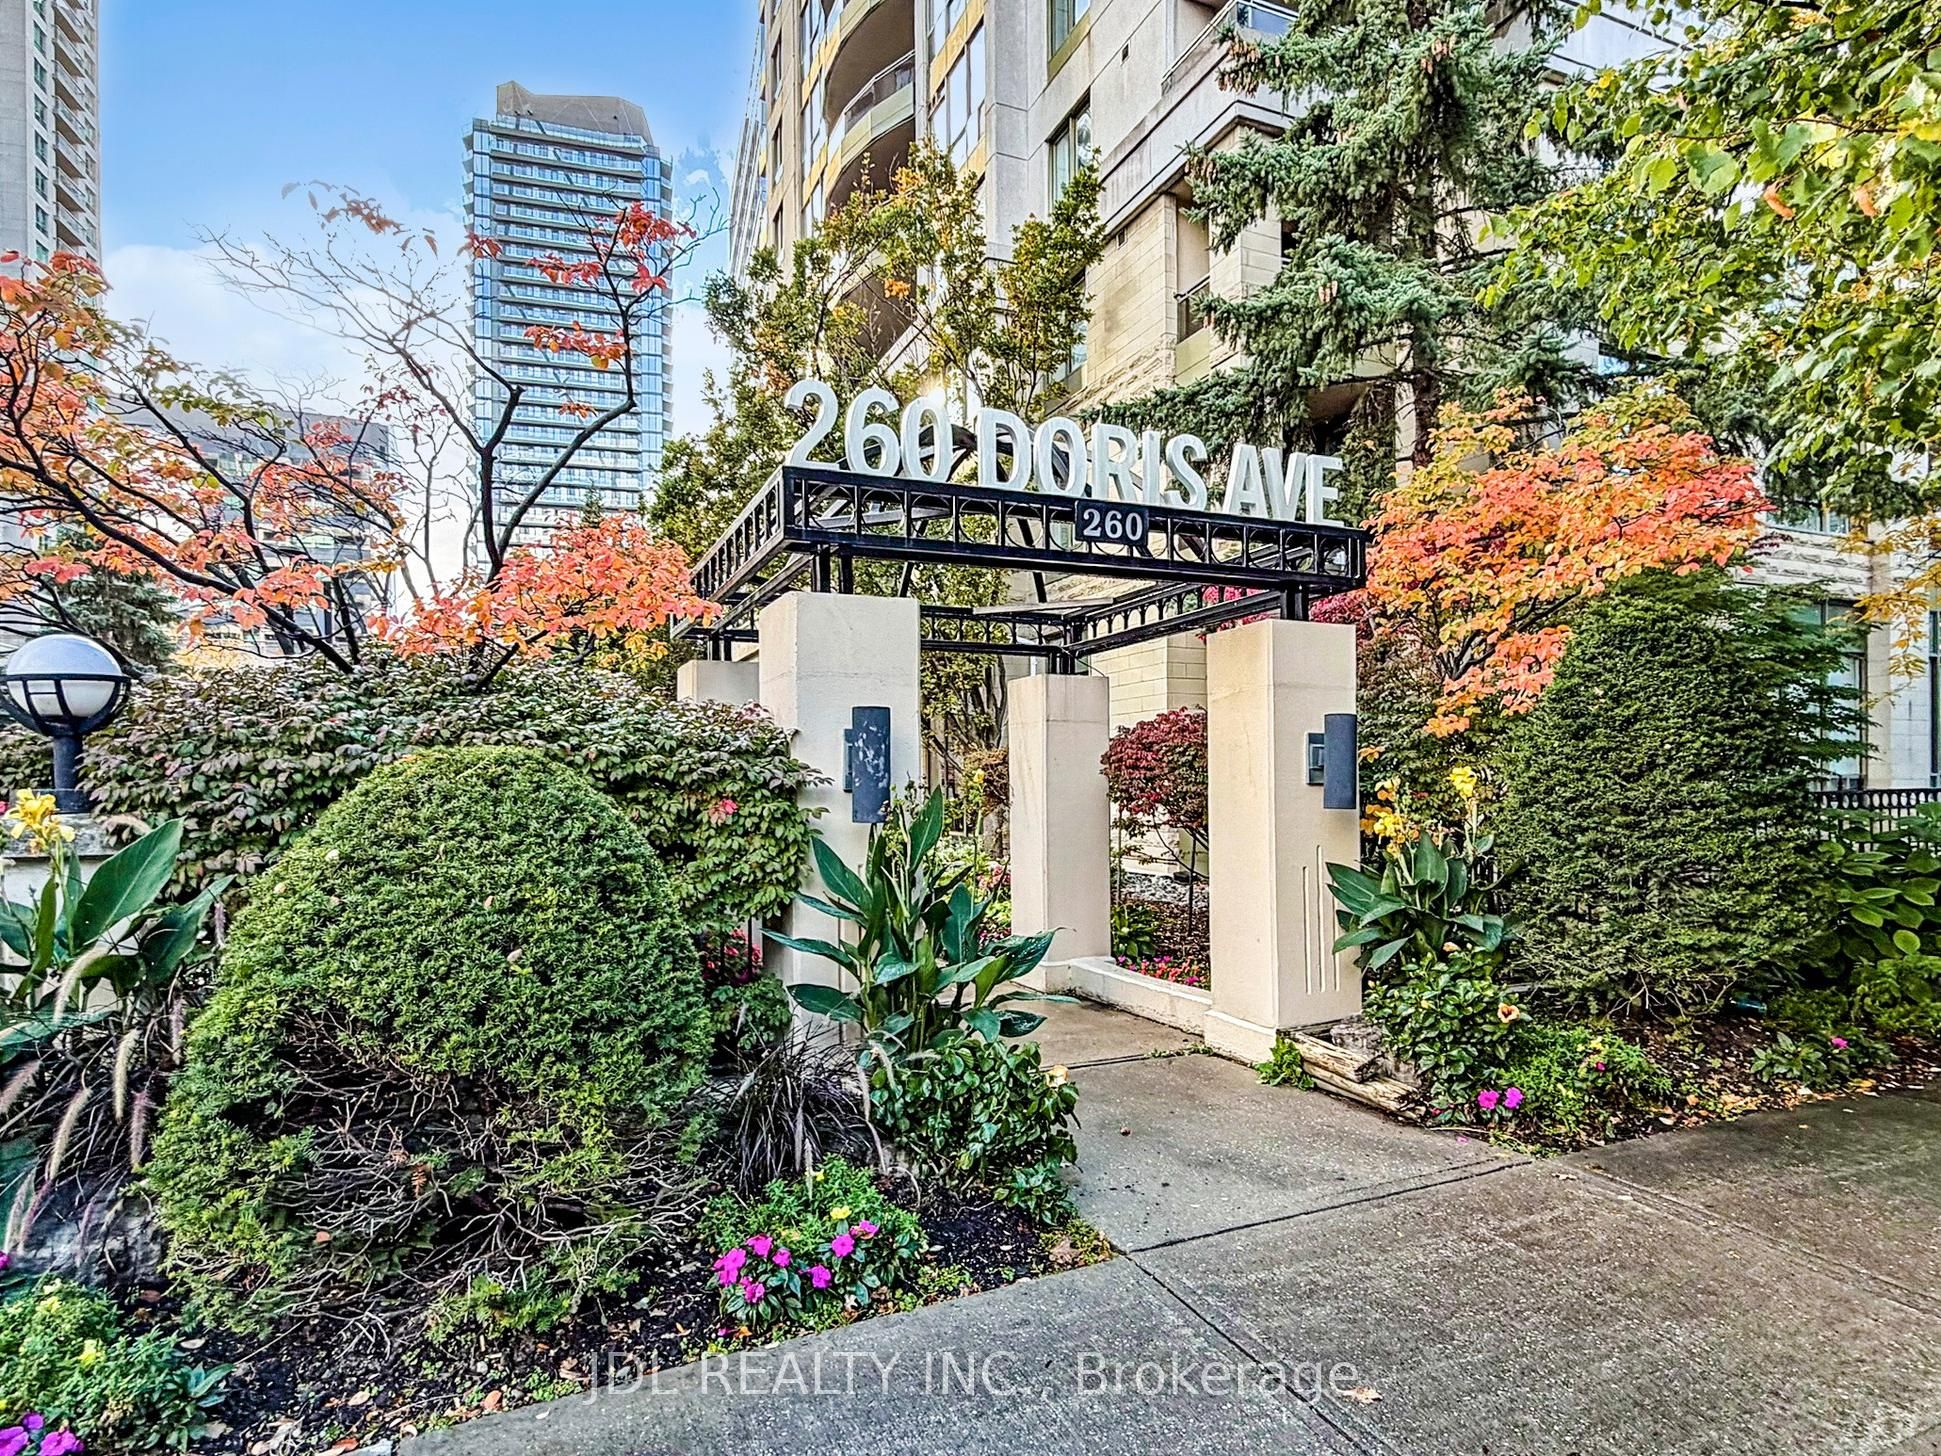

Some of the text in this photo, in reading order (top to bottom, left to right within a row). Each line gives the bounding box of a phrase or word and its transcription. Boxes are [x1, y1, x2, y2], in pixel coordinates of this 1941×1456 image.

[784, 379, 1345, 527] 260 DORIS AVE
[1083, 508, 1143, 540] 260
